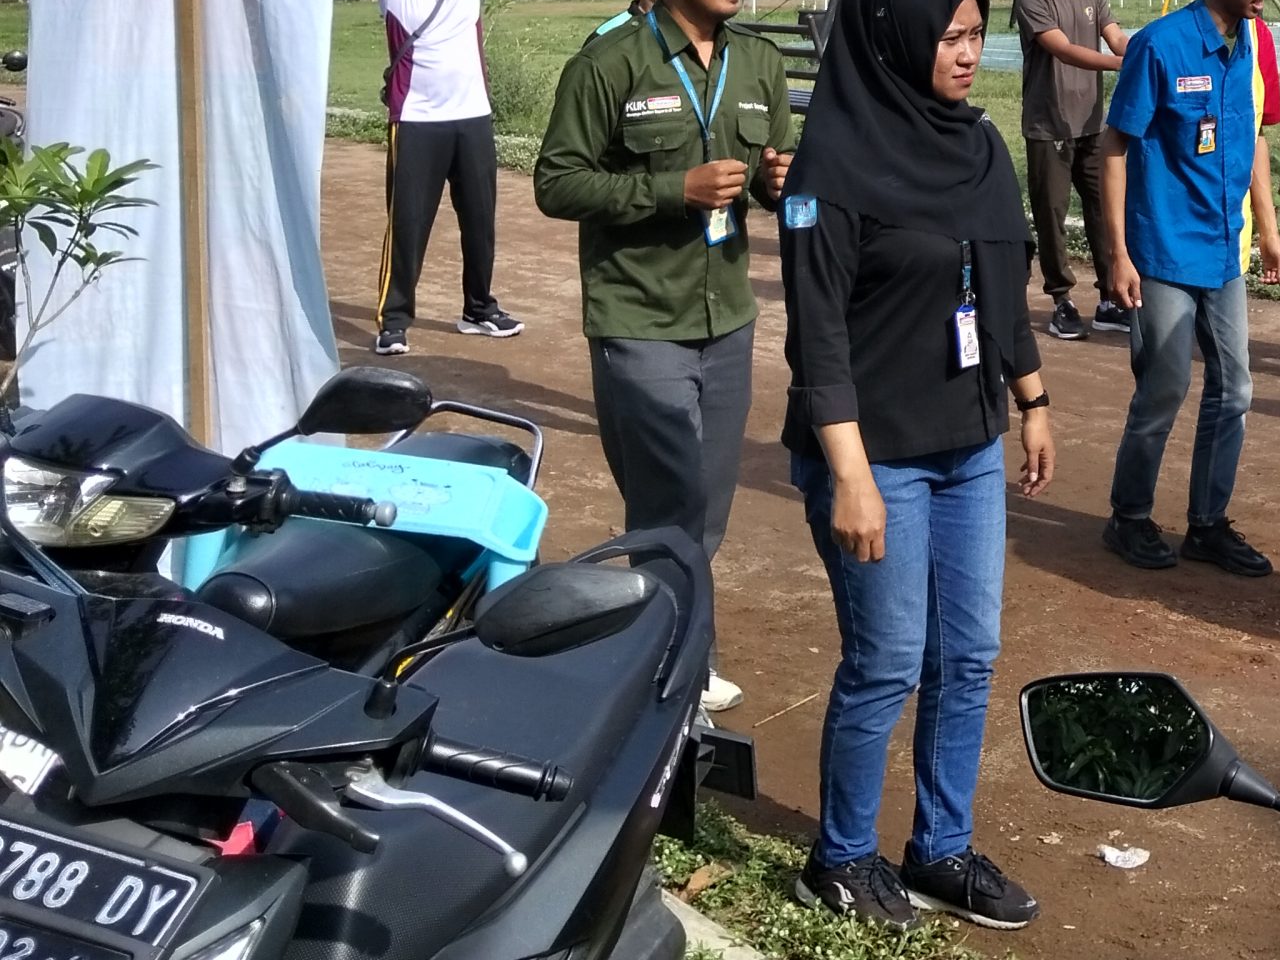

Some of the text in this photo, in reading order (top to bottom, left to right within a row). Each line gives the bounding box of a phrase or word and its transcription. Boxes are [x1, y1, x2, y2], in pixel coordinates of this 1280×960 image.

[156, 612, 225, 640] HONDA
[0, 836, 177, 936] 788 DY
